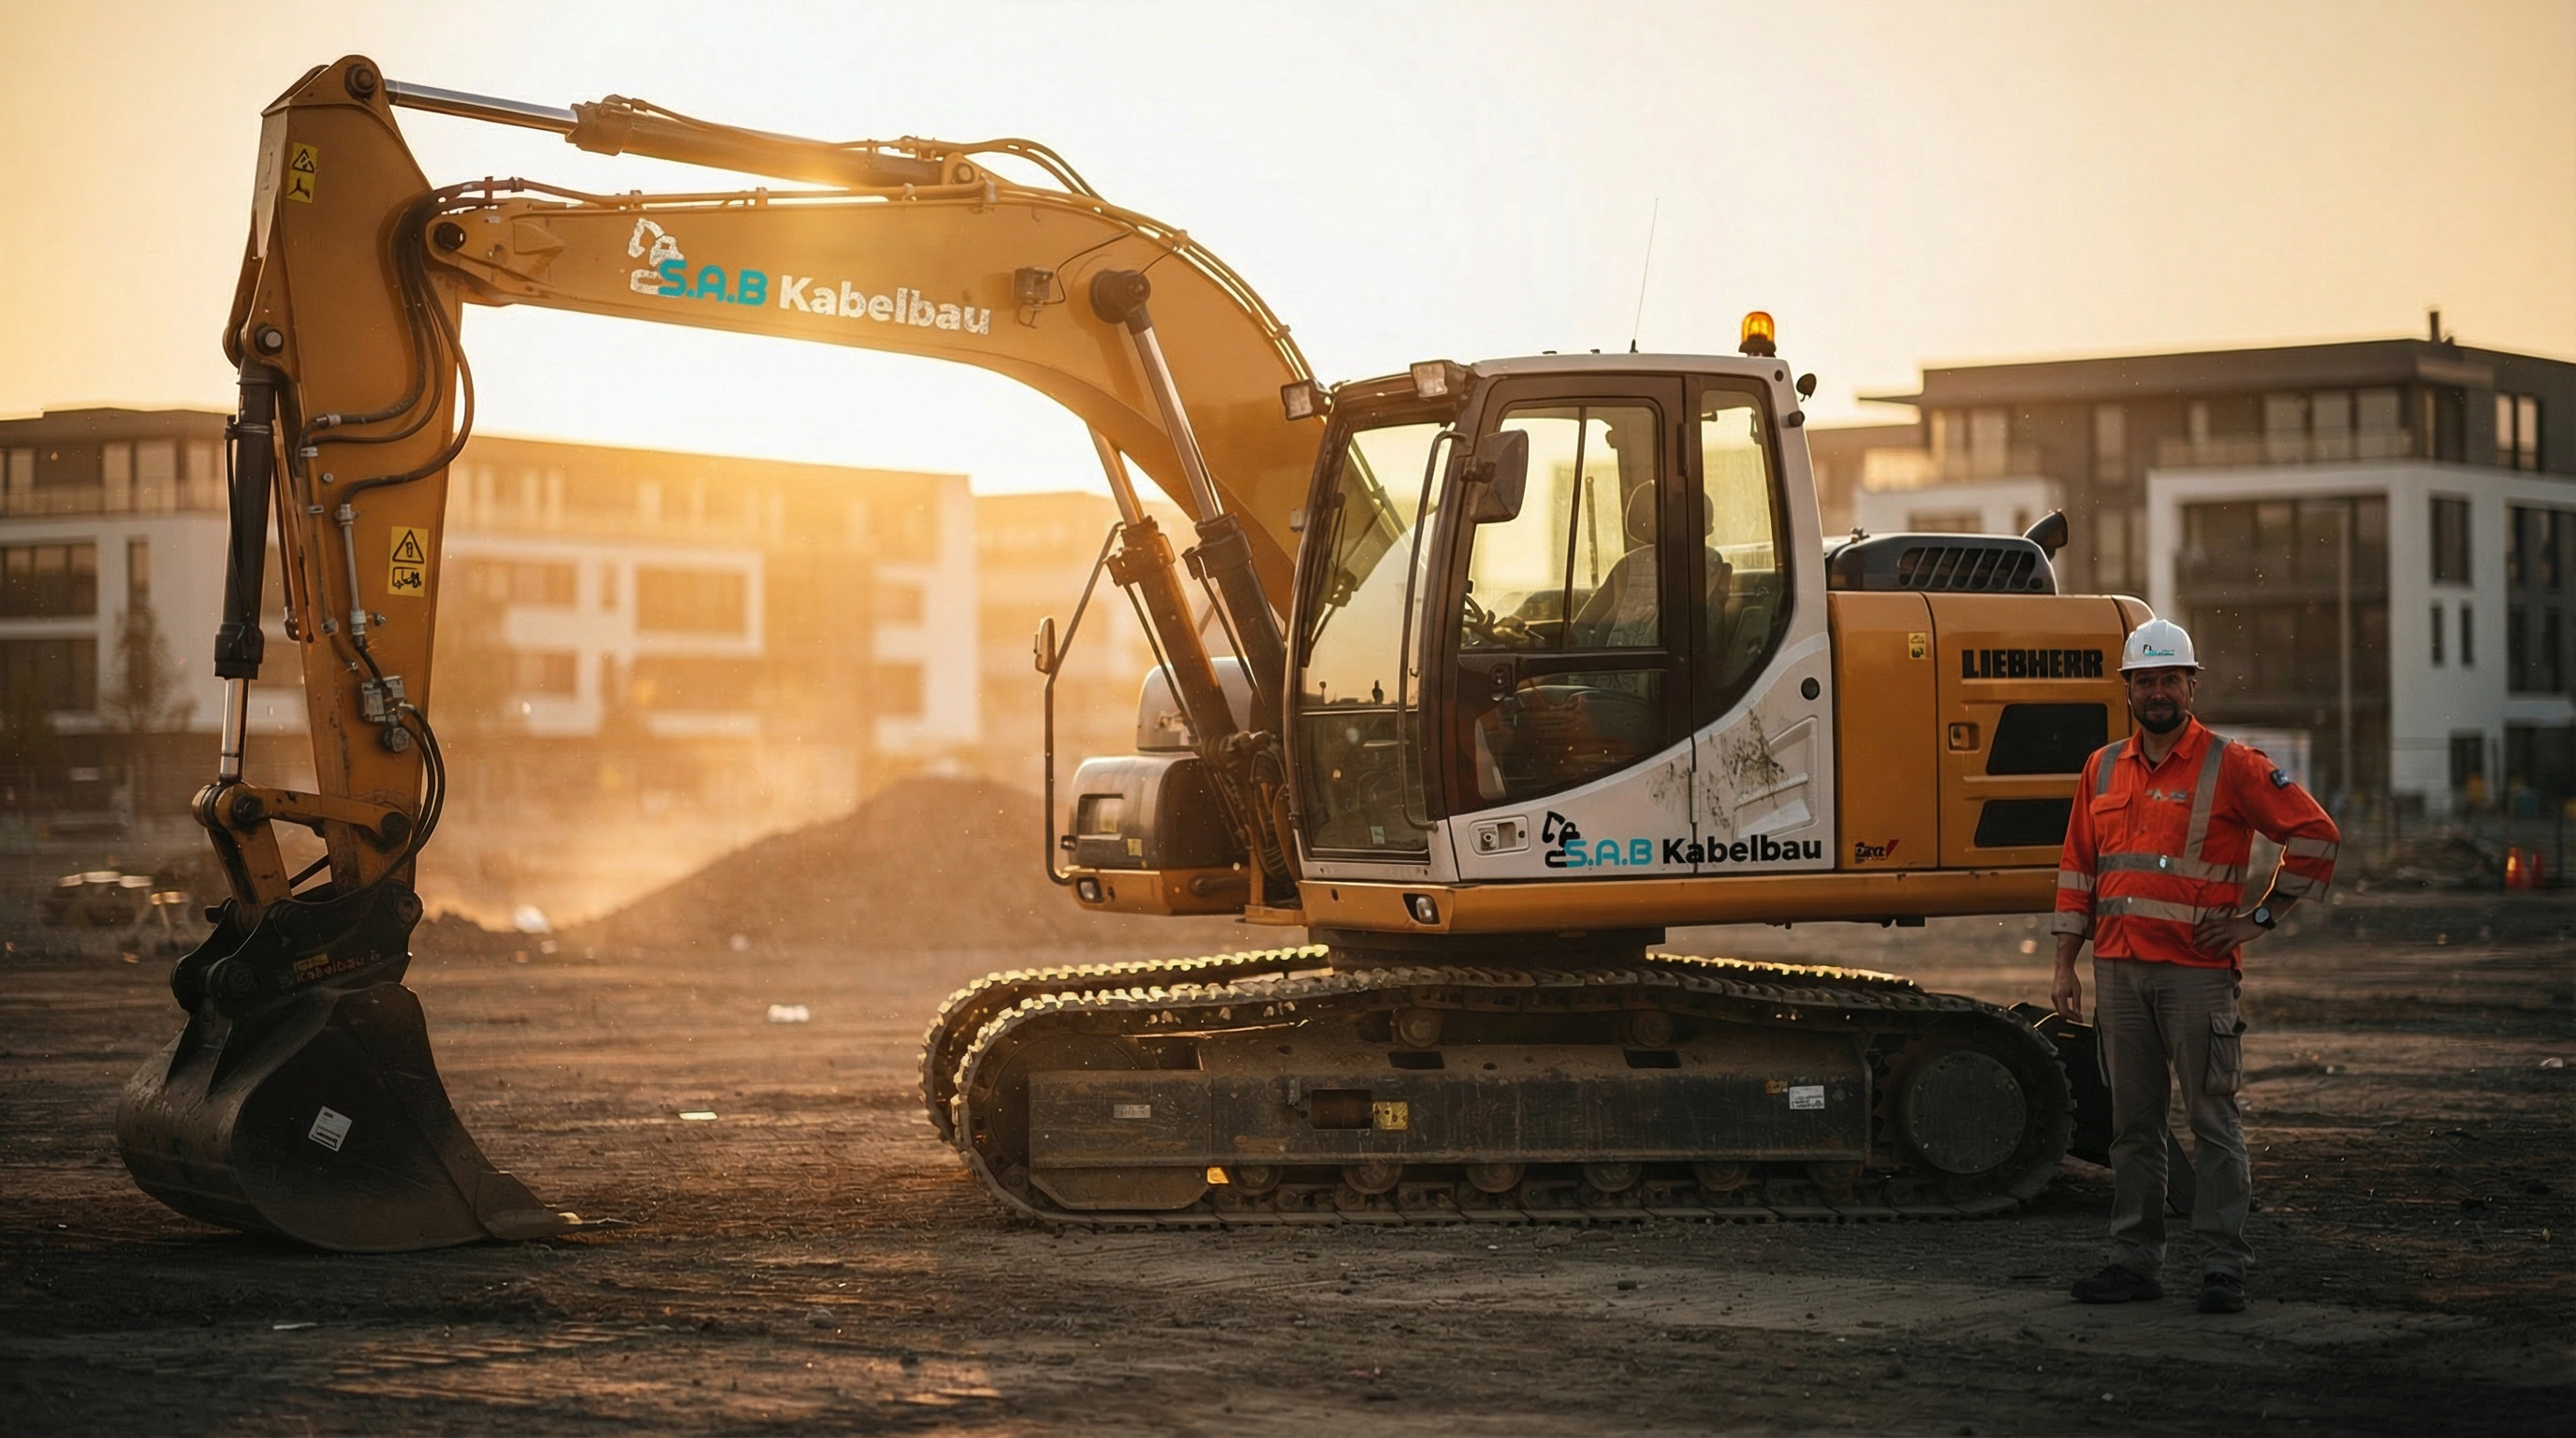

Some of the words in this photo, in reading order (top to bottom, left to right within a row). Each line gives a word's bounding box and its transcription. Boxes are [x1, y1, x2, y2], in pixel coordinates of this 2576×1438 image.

[658, 258, 768, 306] S.A.B
[779, 274, 990, 334] Kabelbau
[1962, 649, 2103, 678] LIEBHERR
[1564, 839, 1652, 867] S.A.B
[1662, 834, 1822, 864] Kabelbau
